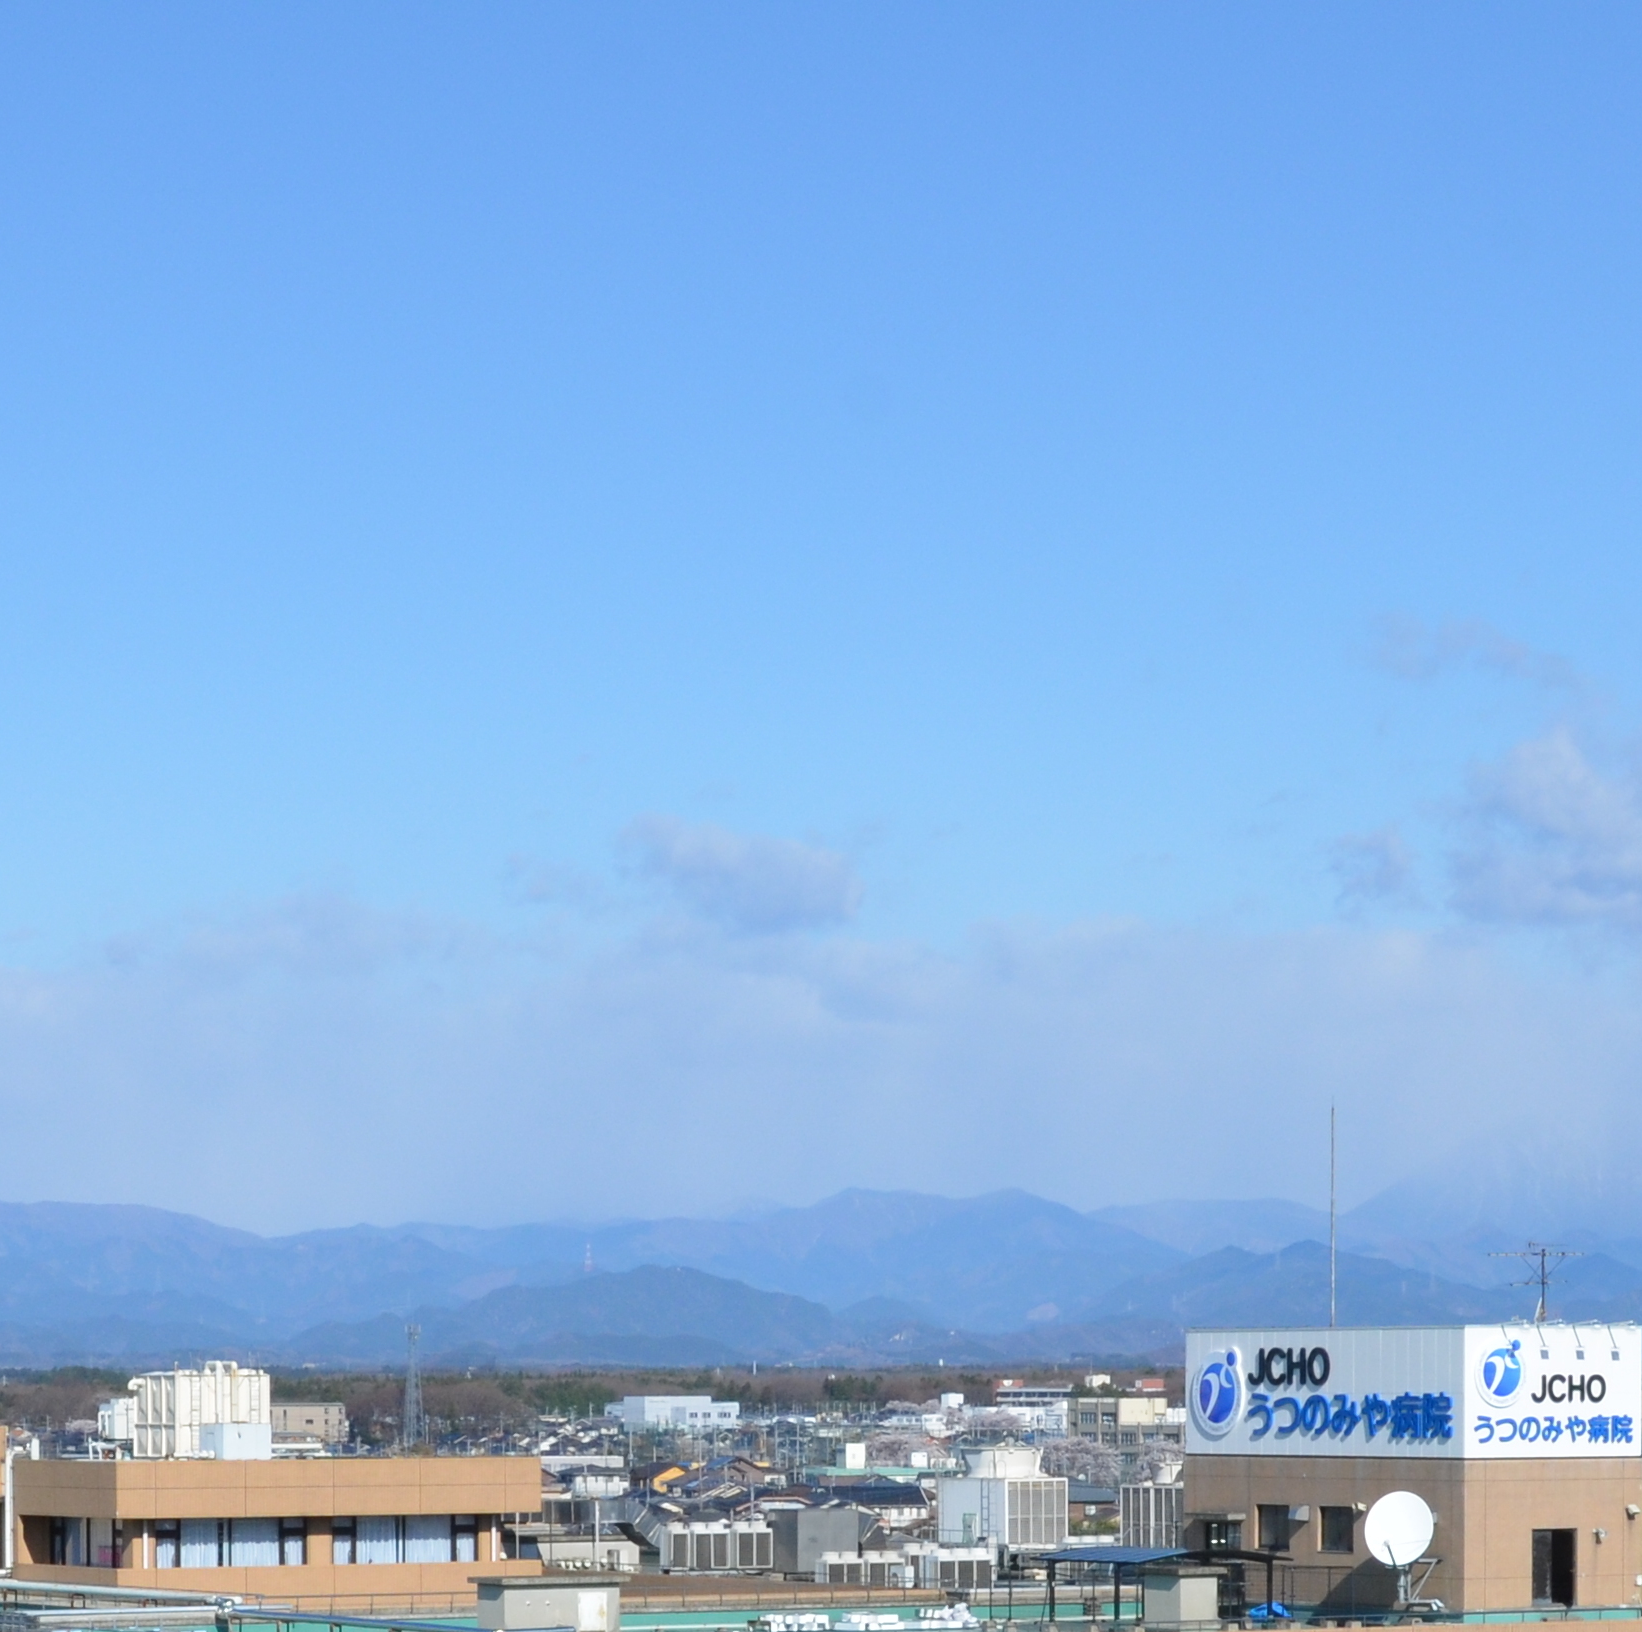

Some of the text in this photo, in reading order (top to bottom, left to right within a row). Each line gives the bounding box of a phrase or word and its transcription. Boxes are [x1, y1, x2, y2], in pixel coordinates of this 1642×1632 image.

[1248, 1347, 1331, 1387] JCHO
[1532, 1374, 1606, 1403] JCHO
[1248, 1391, 1454, 1440] うつのみや病院
[1474, 1415, 1633, 1444] うつのみや病院
